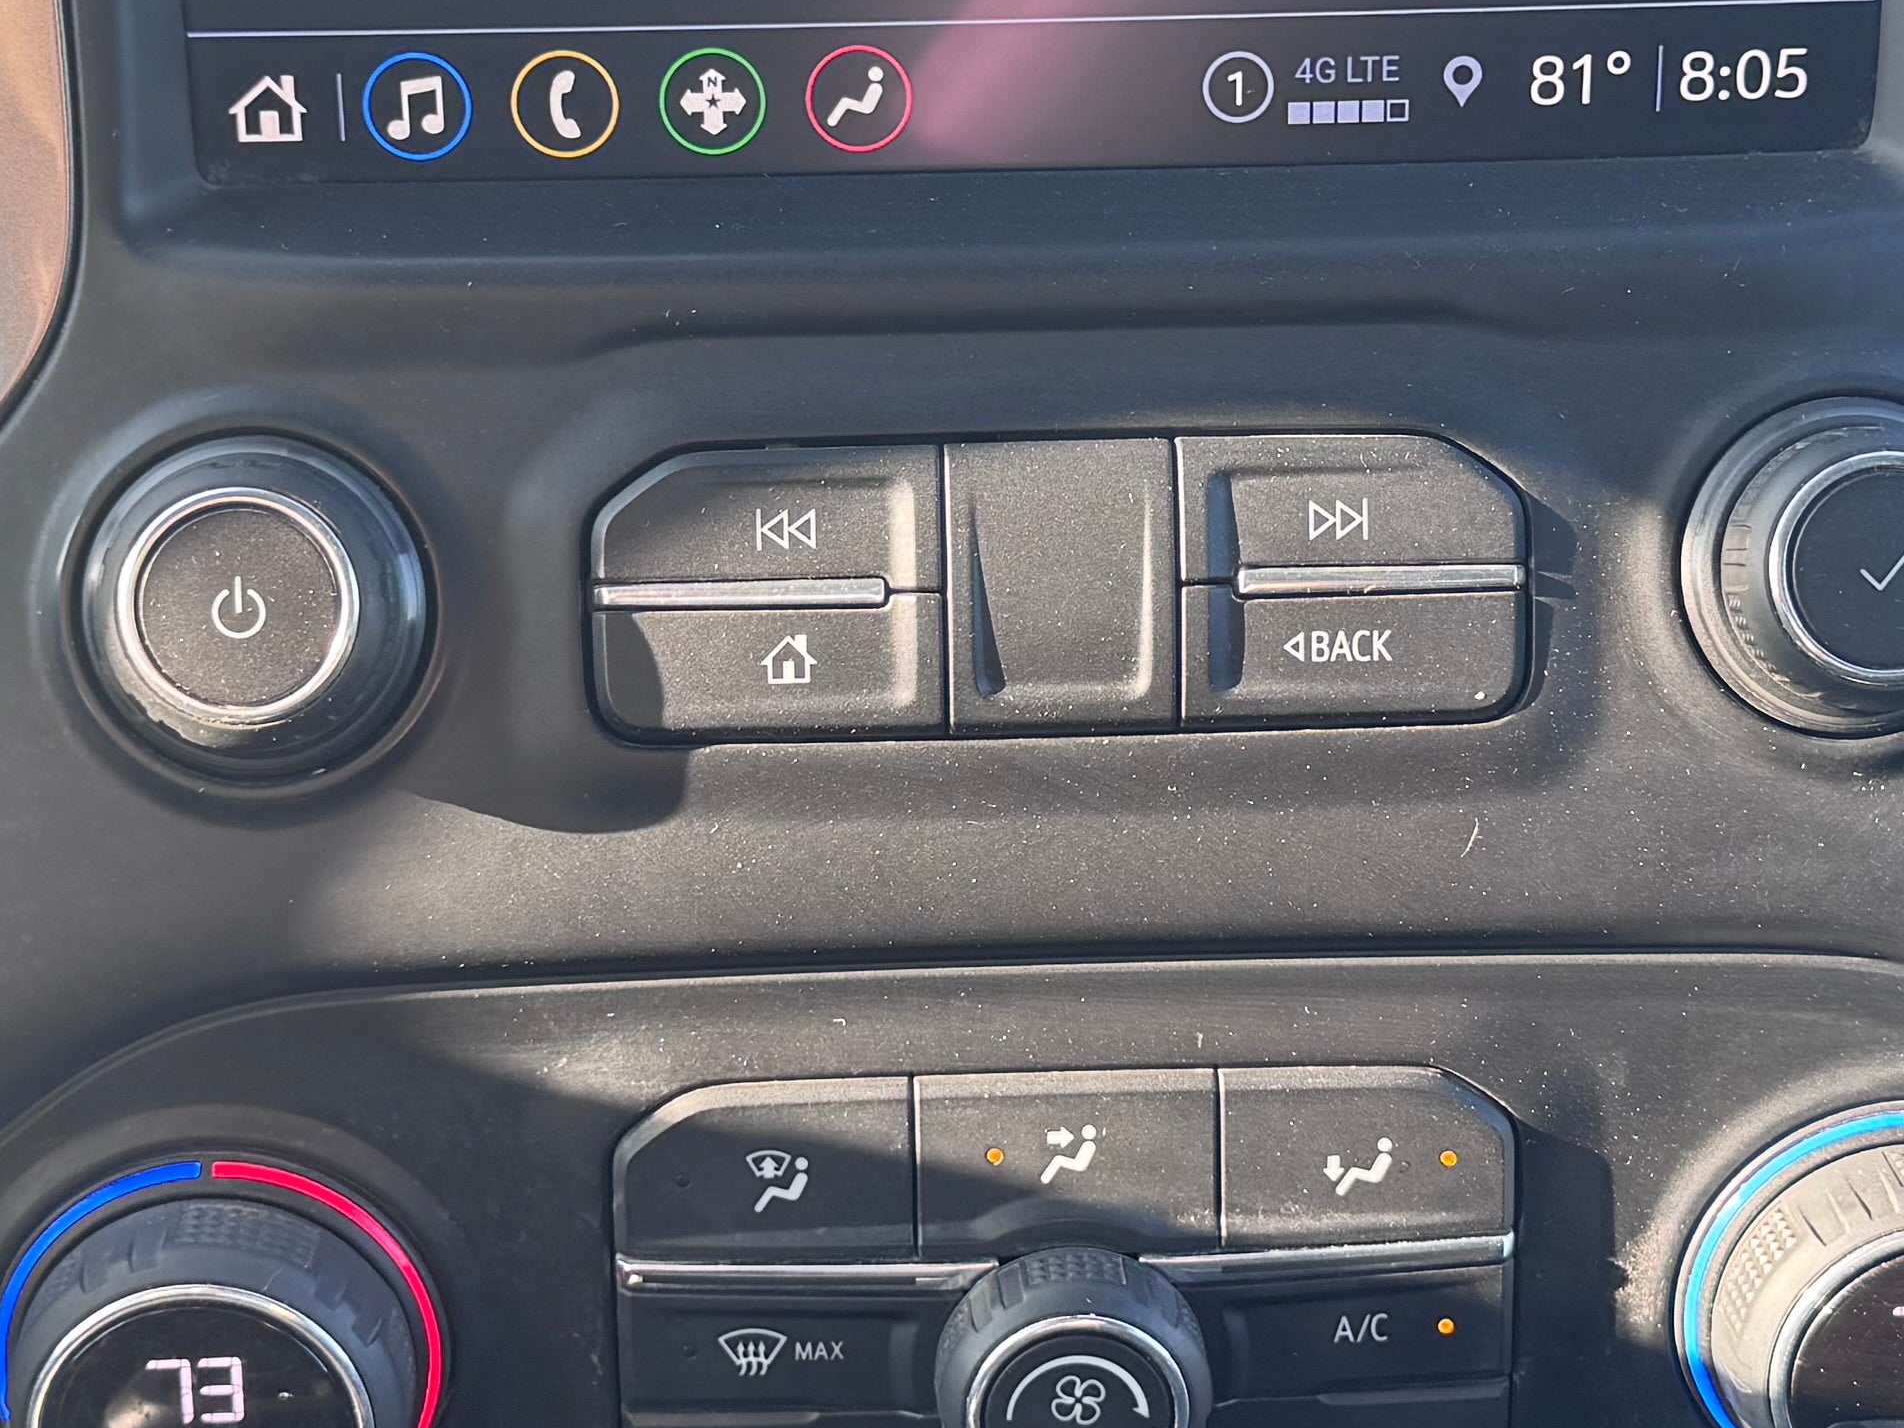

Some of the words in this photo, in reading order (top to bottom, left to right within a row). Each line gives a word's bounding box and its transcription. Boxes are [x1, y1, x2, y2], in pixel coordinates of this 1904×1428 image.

[1293, 57, 1337, 84] 4G
[1346, 55, 1400, 83] LTE
[1527, 50, 1633, 107] 81°
[1676, 46, 1810, 102] 8:05
[1226, 71, 1246, 107] 1
[1310, 628, 1393, 664] BACK
[1333, 1312, 1390, 1344] A/C
[794, 1340, 844, 1362] MAX
[144, 1355, 246, 1425] 73
